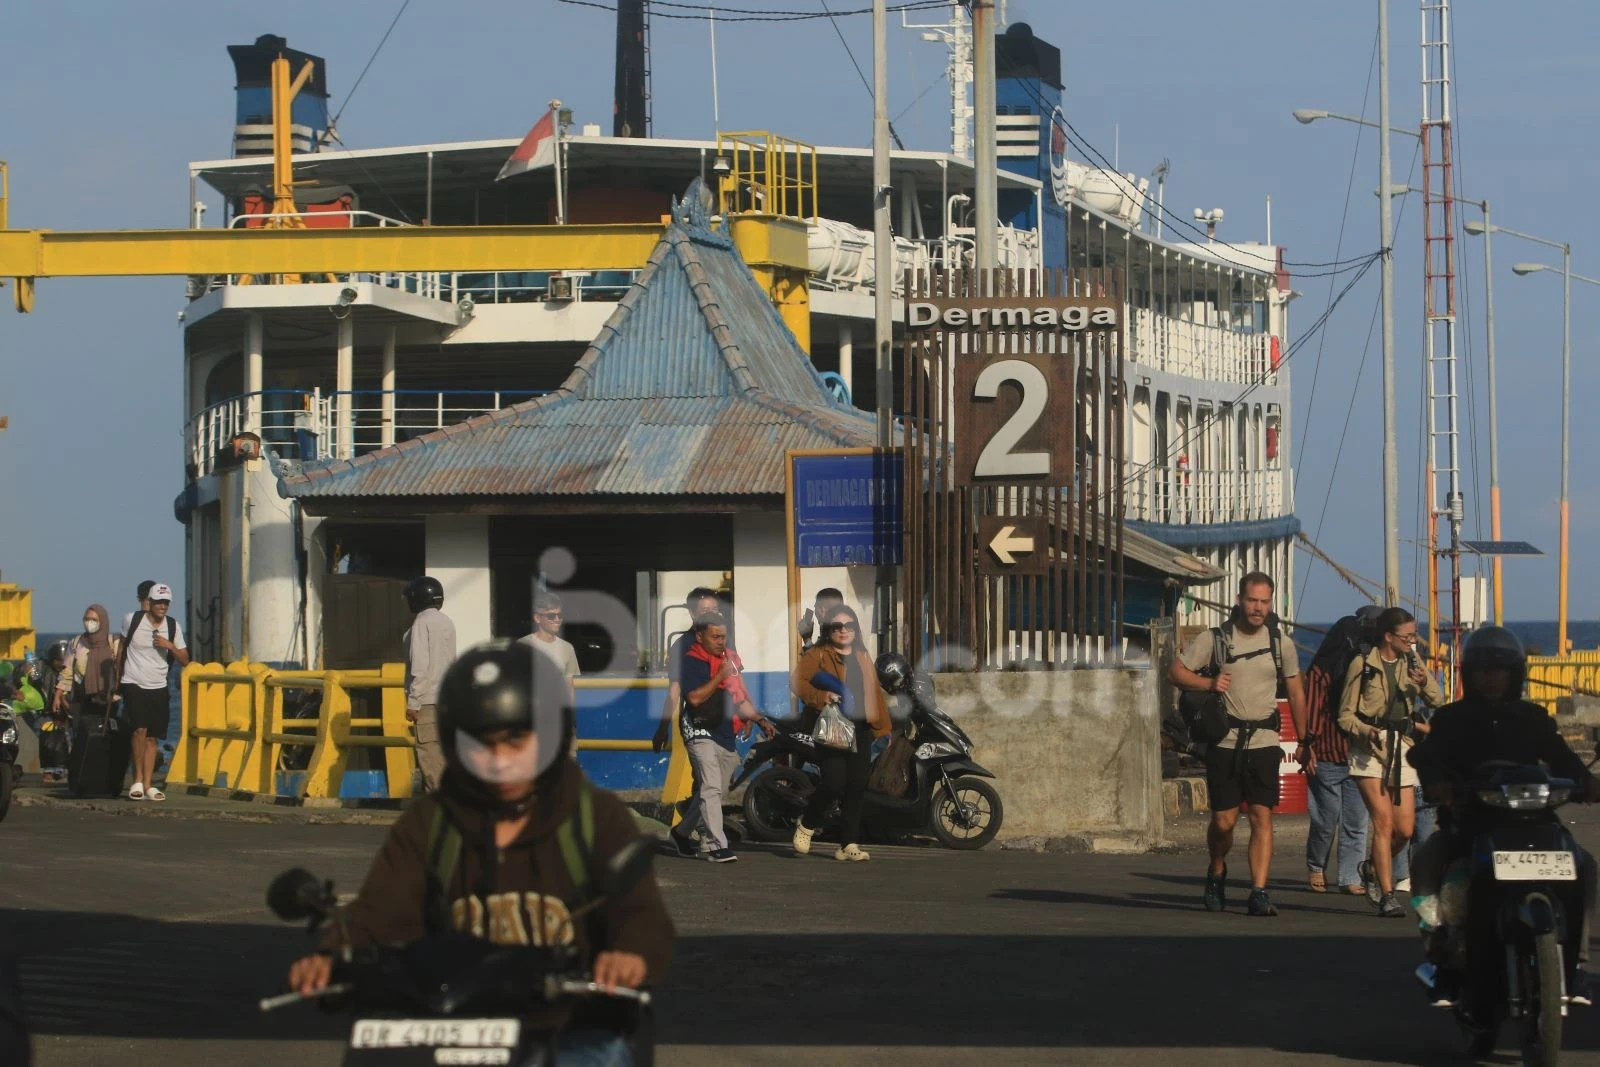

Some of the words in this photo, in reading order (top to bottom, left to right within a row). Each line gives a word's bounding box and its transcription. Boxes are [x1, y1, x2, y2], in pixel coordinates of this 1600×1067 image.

[908, 302, 1117, 330] Dermaga
[974, 359, 1050, 477] 2
[806, 478, 867, 508] DERMAGA
[1495, 853, 1511, 865] DK
[1518, 853, 1548, 865] 4472
